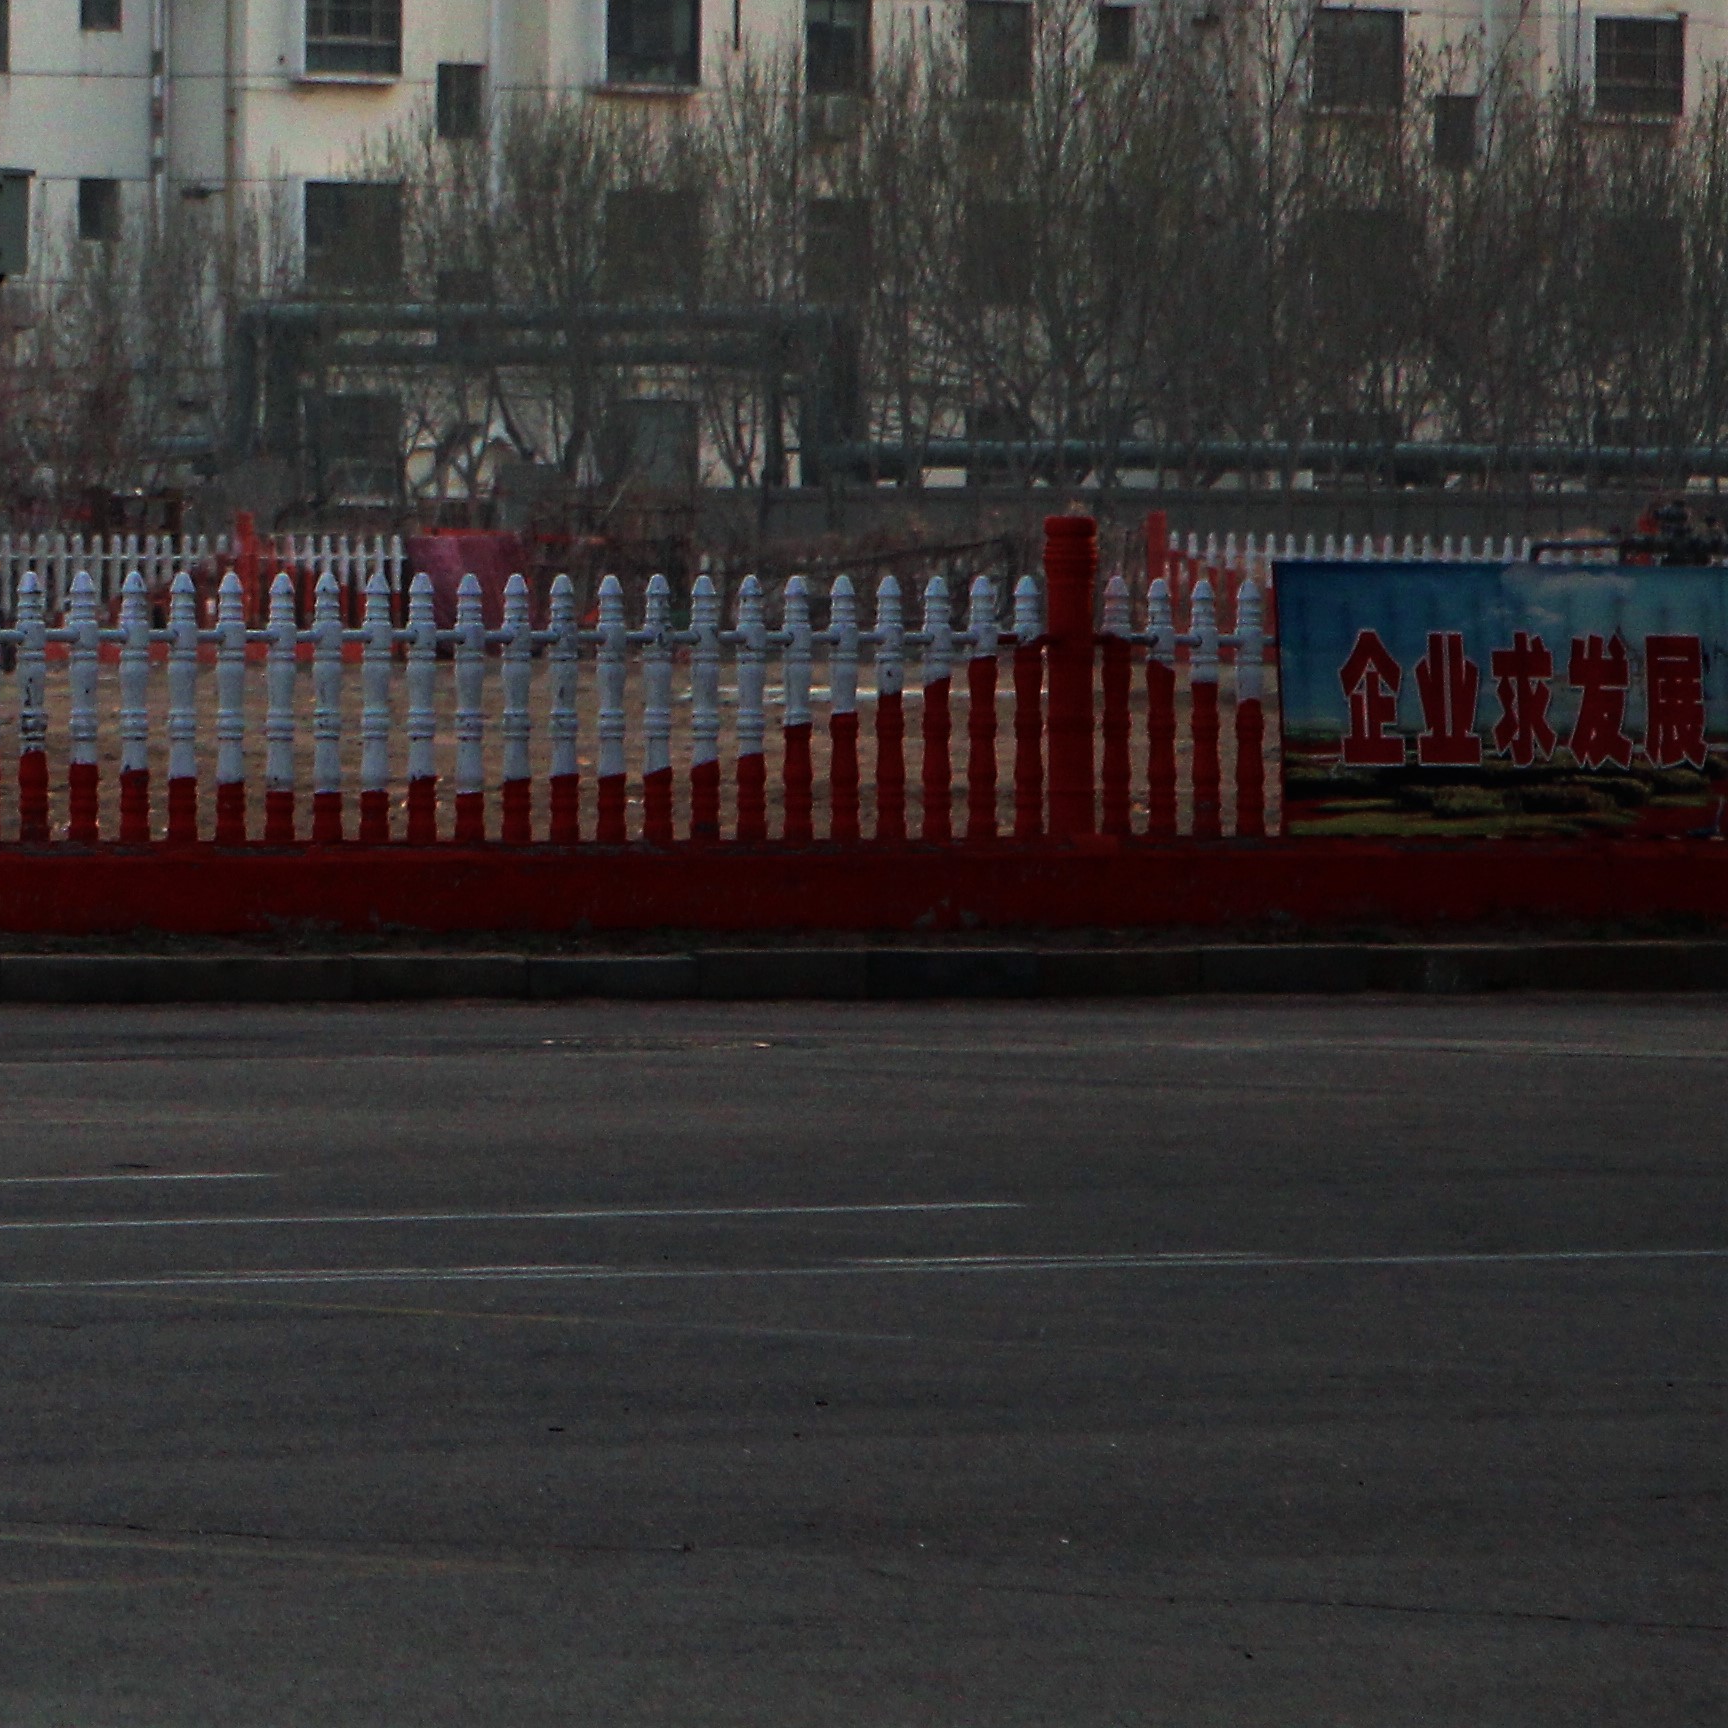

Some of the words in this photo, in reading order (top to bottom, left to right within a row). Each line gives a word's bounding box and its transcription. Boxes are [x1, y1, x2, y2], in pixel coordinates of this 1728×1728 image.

[1339, 629, 1709, 770] 企业求发展
